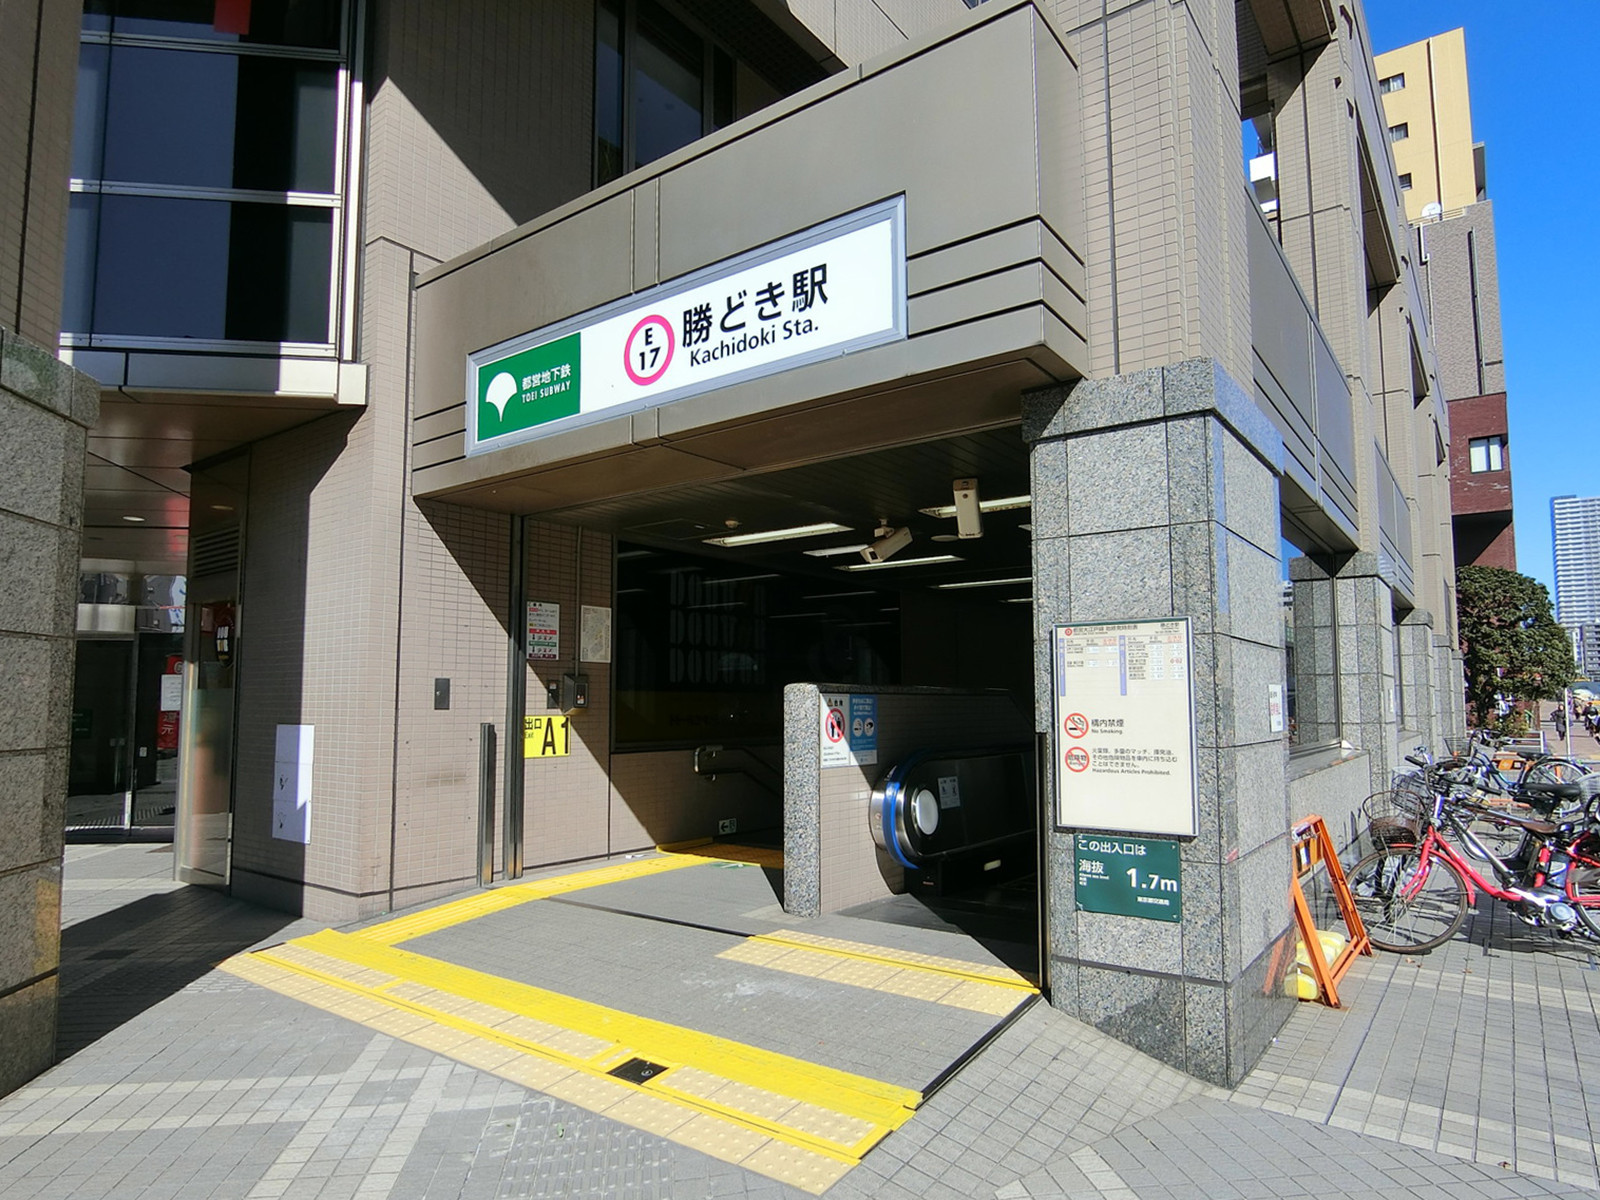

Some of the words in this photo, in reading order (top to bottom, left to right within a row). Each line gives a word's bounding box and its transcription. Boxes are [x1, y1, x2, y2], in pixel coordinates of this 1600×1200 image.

[682, 263, 828, 348] 勝どき駅
[644, 327, 653, 345] E
[690, 325, 775, 367] Kachidoki
[783, 318, 819, 340] Sta.
[639, 347, 661, 370] 17
[522, 363, 571, 390] 都営地下鉄
[522, 391, 538, 403] TOEI
[540, 380, 571, 398] SUBWAY
[1091, 719, 1124, 727] 構内禁煙
[542, 717, 569, 755] A1
[1079, 840, 1146, 855] この出入口は
[1079, 859, 1104, 874] 海抜
[1126, 868, 1177, 892] 1.7m
